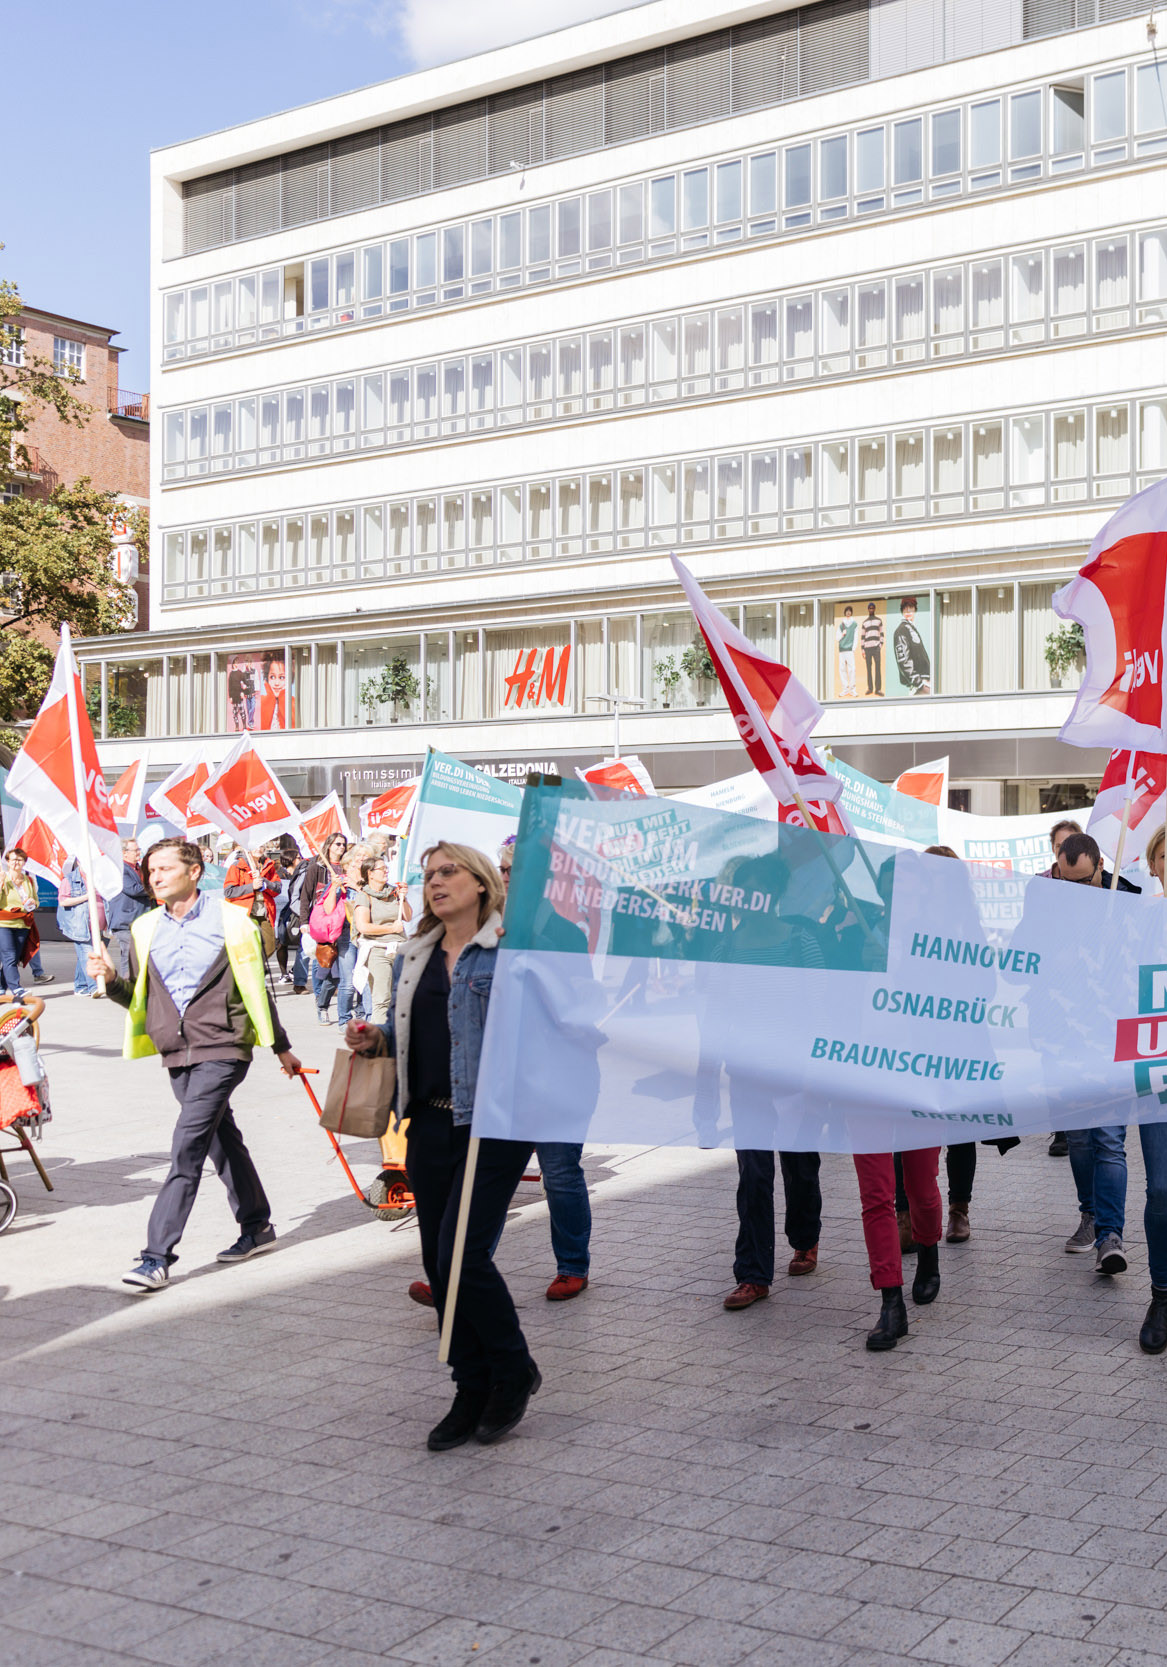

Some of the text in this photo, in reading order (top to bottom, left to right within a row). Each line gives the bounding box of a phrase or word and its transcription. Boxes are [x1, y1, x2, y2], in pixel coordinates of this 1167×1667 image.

[504, 644, 571, 708] H&M
[434, 760, 463, 778] VER.DI
[465, 770, 475, 782] IN
[842, 789, 884, 813] DUNGSHAUS
[865, 786, 878, 800] IM
[643, 810, 672, 830] MIT
[969, 834, 1051, 858] NUR MIT
[542, 878, 567, 902] IN
[570, 882, 727, 933] NIEDERSACHSEN
[708, 882, 773, 914] VER.DI
[910, 932, 1041, 975] HANNOVER
[872, 987, 1018, 1029] OSNABRÜCK
[810, 1037, 1007, 1081] BRAUNSCHWEIG
